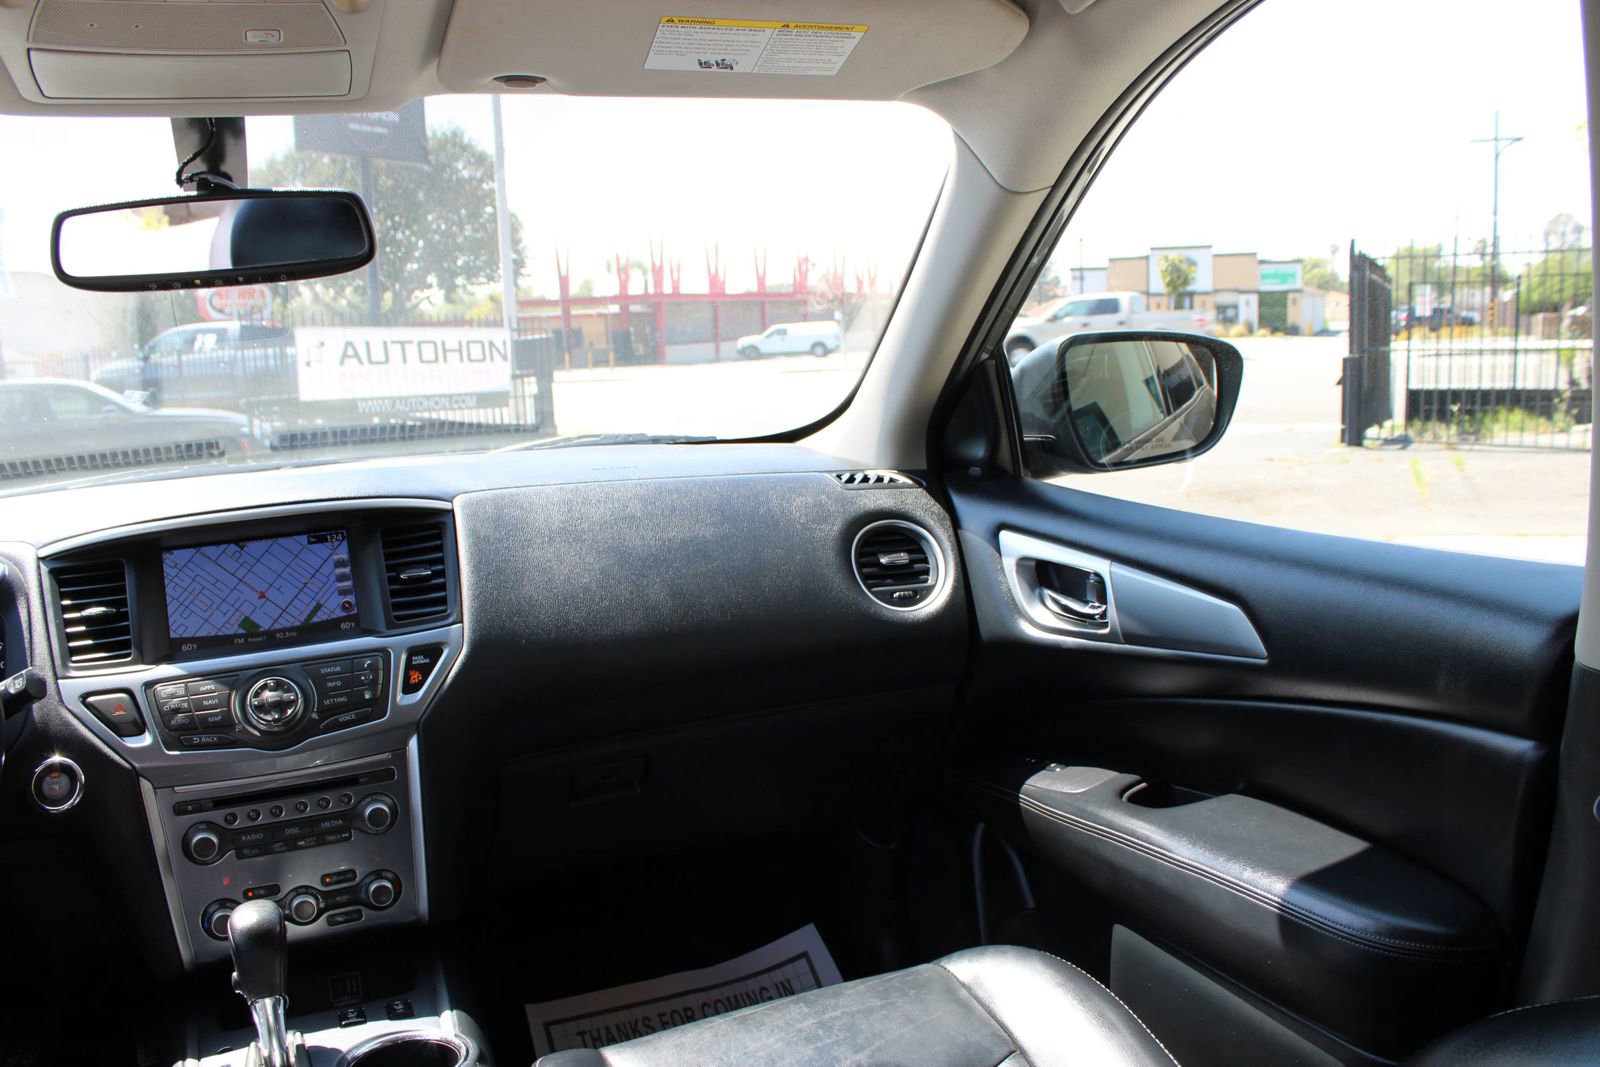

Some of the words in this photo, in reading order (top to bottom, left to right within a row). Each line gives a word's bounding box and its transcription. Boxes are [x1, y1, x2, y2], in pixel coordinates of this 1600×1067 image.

[339, 340, 509, 366] AUTOHON
[356, 395, 478, 413] WWW.AUTOHON.COM
[320, 666, 342, 674] STATUS
[327, 680, 342, 688] INFO
[203, 698, 219, 706] NAVI
[323, 696, 348, 705] SETTING
[170, 718, 190, 726] AUDIO
[339, 714, 356, 722] VOICE
[320, 819, 344, 828] MEDIA
[284, 826, 300, 835] DISC
[241, 832, 264, 841] RADIO
[575, 1017, 657, 1050] THANKS
[657, 1007, 697, 1031] FOR
[701, 986, 773, 1018] COMING
[774, 978, 795, 998] IN
